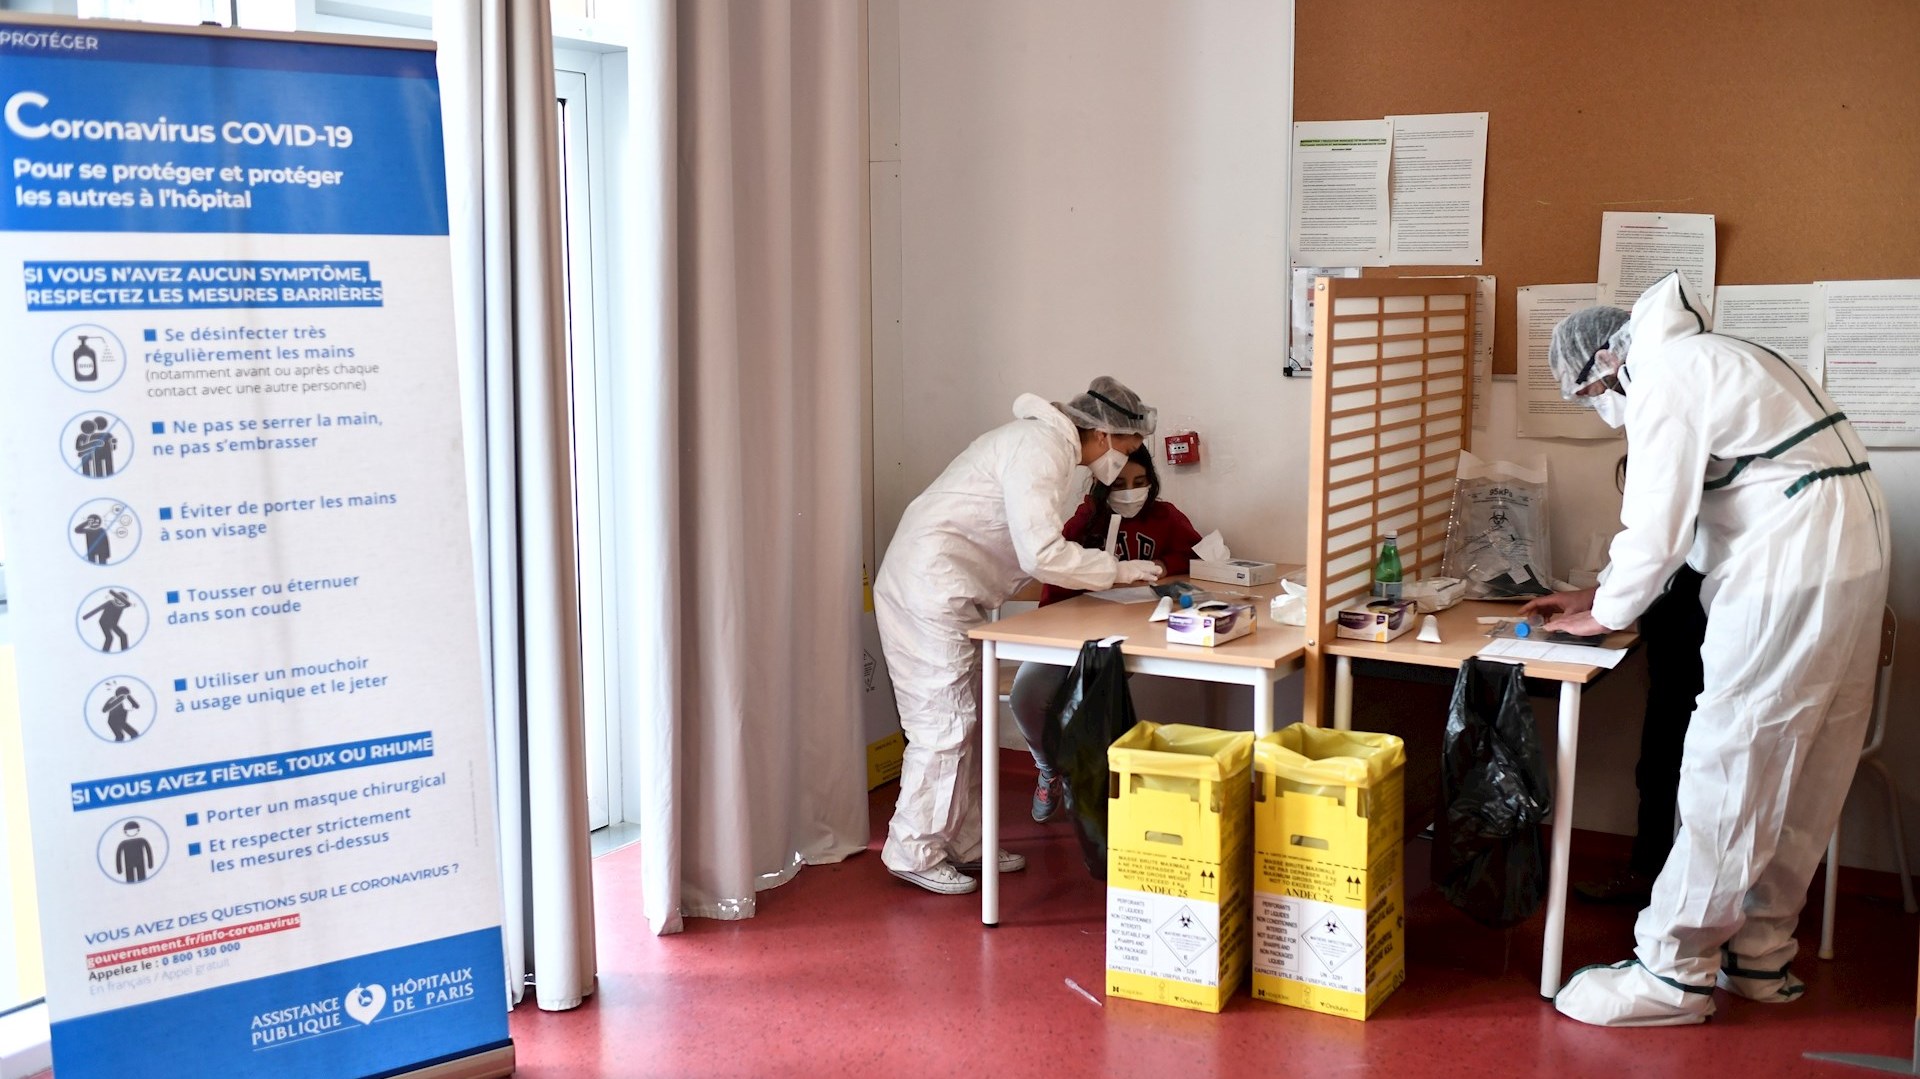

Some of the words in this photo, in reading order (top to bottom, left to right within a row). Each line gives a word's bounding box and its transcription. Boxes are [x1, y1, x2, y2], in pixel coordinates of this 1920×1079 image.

[0, 31, 98, 50] PROTÉGER
[4, 91, 216, 144] Coronavirus
[221, 121, 353, 148] COVID-19
[14, 159, 73, 179] Pour
[79, 165, 107, 179] se
[113, 161, 214, 184] protéger
[219, 165, 244, 181] et
[249, 164, 343, 187] protéger
[16, 186, 50, 206] les
[57, 189, 134, 207] autres
[140, 187, 154, 207] à
[159, 187, 251, 211] l'hôpital
[24, 268, 44, 283] SI
[49, 267, 107, 283] VOUS
[187, 267, 255, 282] AUCUN
[260, 263, 368, 284] SYMPTÔME,
[28, 289, 144, 304] RESPECTEZ
[148, 289, 183, 304] LES
[187, 288, 278, 303] MESURES
[282, 284, 383, 301] BARRIÈRES
[165, 328, 185, 341] Se
[191, 326, 288, 341] désinfecter
[293, 325, 326, 339] très
[145, 347, 273, 367] régulièrement
[277, 346, 299, 360] les
[304, 346, 355, 358] mains
[145, 366, 232, 382] (notamment
[235, 367, 270, 377] avant
[275, 367, 291, 376] ou
[295, 364, 330, 380] après
[333, 362, 380, 378] chaque
[147, 386, 198, 398] contact
[202, 386, 233, 396] avec
[237, 384, 261, 394] une
[265, 383, 298, 394] autre
[302, 379, 367, 395] personne)
[173, 420, 197, 434] Ne
[203, 421, 233, 437] pas
[239, 419, 257, 430] se
[261, 417, 312, 430] serrer
[317, 413, 333, 427] la
[338, 412, 383, 428] main,
[153, 443, 175, 456] ne
[181, 441, 211, 458] pas
[181, 502, 233, 520] Éviter
[239, 501, 259, 515] de
[264, 498, 315, 516] porter
[320, 495, 343, 509] les
[348, 492, 396, 506] mains
[160, 526, 170, 541] à
[176, 526, 207, 540] son
[212, 521, 267, 540] visage
[187, 586, 257, 602] Tousser
[261, 583, 282, 596] ou
[287, 575, 359, 593] éternuer
[168, 609, 209, 625] dans
[215, 606, 246, 620] son
[251, 600, 301, 617] coude
[195, 672, 259, 690] Utiliser
[265, 669, 286, 682] un
[291, 657, 369, 679] mouchoir
[175, 697, 185, 712] à
[191, 695, 242, 713] usage
[247, 687, 306, 707] unique
[311, 684, 327, 696] et
[332, 681, 345, 694] le
[349, 674, 388, 695] jeter
[72, 789, 90, 806] SI
[96, 780, 152, 802] VOUS
[157, 772, 206, 794] AVEZ
[212, 762, 282, 785] FIÈVRE,
[289, 752, 334, 772] TOUX
[340, 747, 367, 764] OU
[371, 736, 433, 758] RHUME
[207, 804, 261, 822] Porter
[267, 801, 288, 813] un
[294, 790, 358, 810] masque
[362, 773, 446, 801] chirurgical
[209, 838, 226, 852] Et
[231, 824, 311, 850] respecter
[317, 806, 411, 833] strictement
[210, 858, 235, 873] les
[240, 846, 312, 867] mesures
[317, 829, 389, 855] ci-dessus
[1140, 885, 1175, 895] ANDEC
[1285, 888, 1320, 899] ANDEC
[85, 929, 129, 944] VOUS
[135, 919, 174, 935] AVEZ
[180, 912, 208, 927] DES
[213, 896, 295, 922] QUESTIONS
[301, 889, 327, 903] SUR
[332, 885, 346, 897] LE
[351, 867, 449, 894] CORONAVIRUS
[452, 864, 459, 875] ?
[87, 915, 300, 968] gouvernement.fr/info-coronavirus
[89, 965, 136, 981] Appelez
[140, 960, 152, 971] le
[162, 957, 169, 966] 0
[173, 952, 194, 965] 800
[198, 947, 217, 960] 130
[220, 942, 241, 955] 000
[162, 966, 192, 982] Appel
[251, 997, 339, 1029] ASSISTANCE
[391, 967, 472, 997] HÔPITAUX
[252, 1013, 341, 1046] PUBLIQUE
[393, 998, 415, 1013] DE
[427, 983, 473, 1004] PARIS
